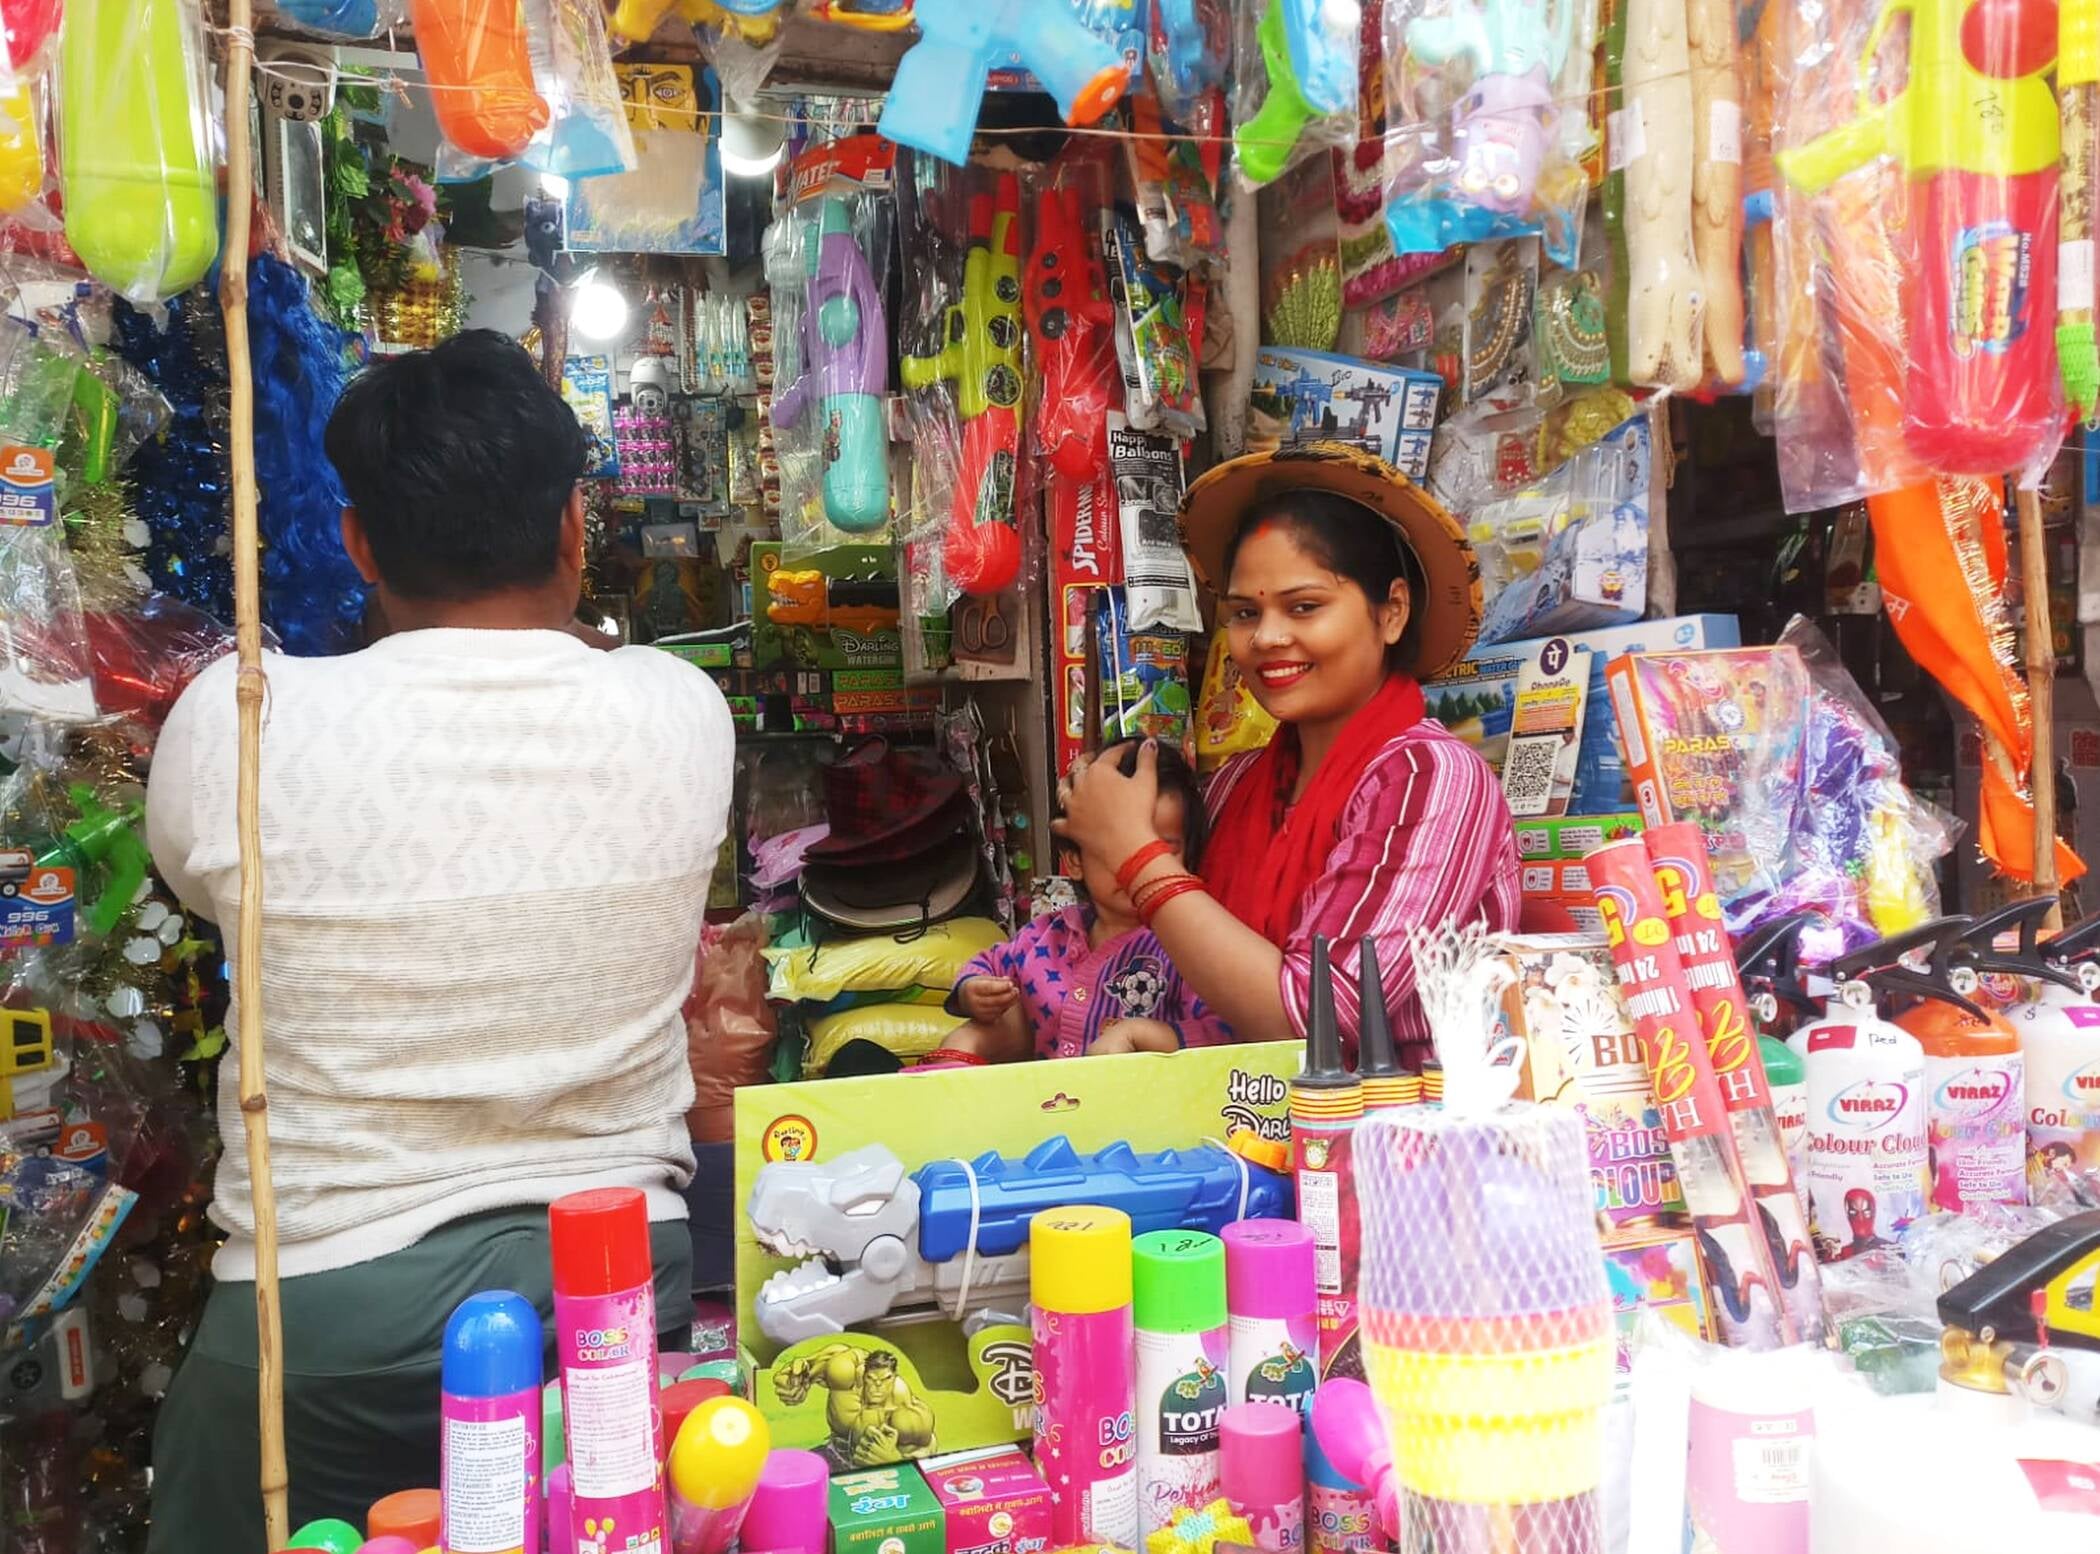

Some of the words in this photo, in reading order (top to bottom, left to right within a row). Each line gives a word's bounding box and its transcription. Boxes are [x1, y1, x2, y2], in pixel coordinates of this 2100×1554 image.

[1113, 432, 1147, 448] Happ
[0, 493, 38, 508] 96
[839, 695, 895, 707] PARAS
[1664, 736, 1731, 754] PARAS
[1227, 1069, 1286, 1105] Hello
[1946, 1084, 2002, 1100] VIRAZ
[1839, 1097, 1897, 1113] VIRAZ
[1881, 1132, 1926, 1155] Clou
[1589, 1162, 1682, 1209] OLOUR
[575, 1327, 630, 1348] BOSS
[1311, 1506, 1372, 1534] BOSS
